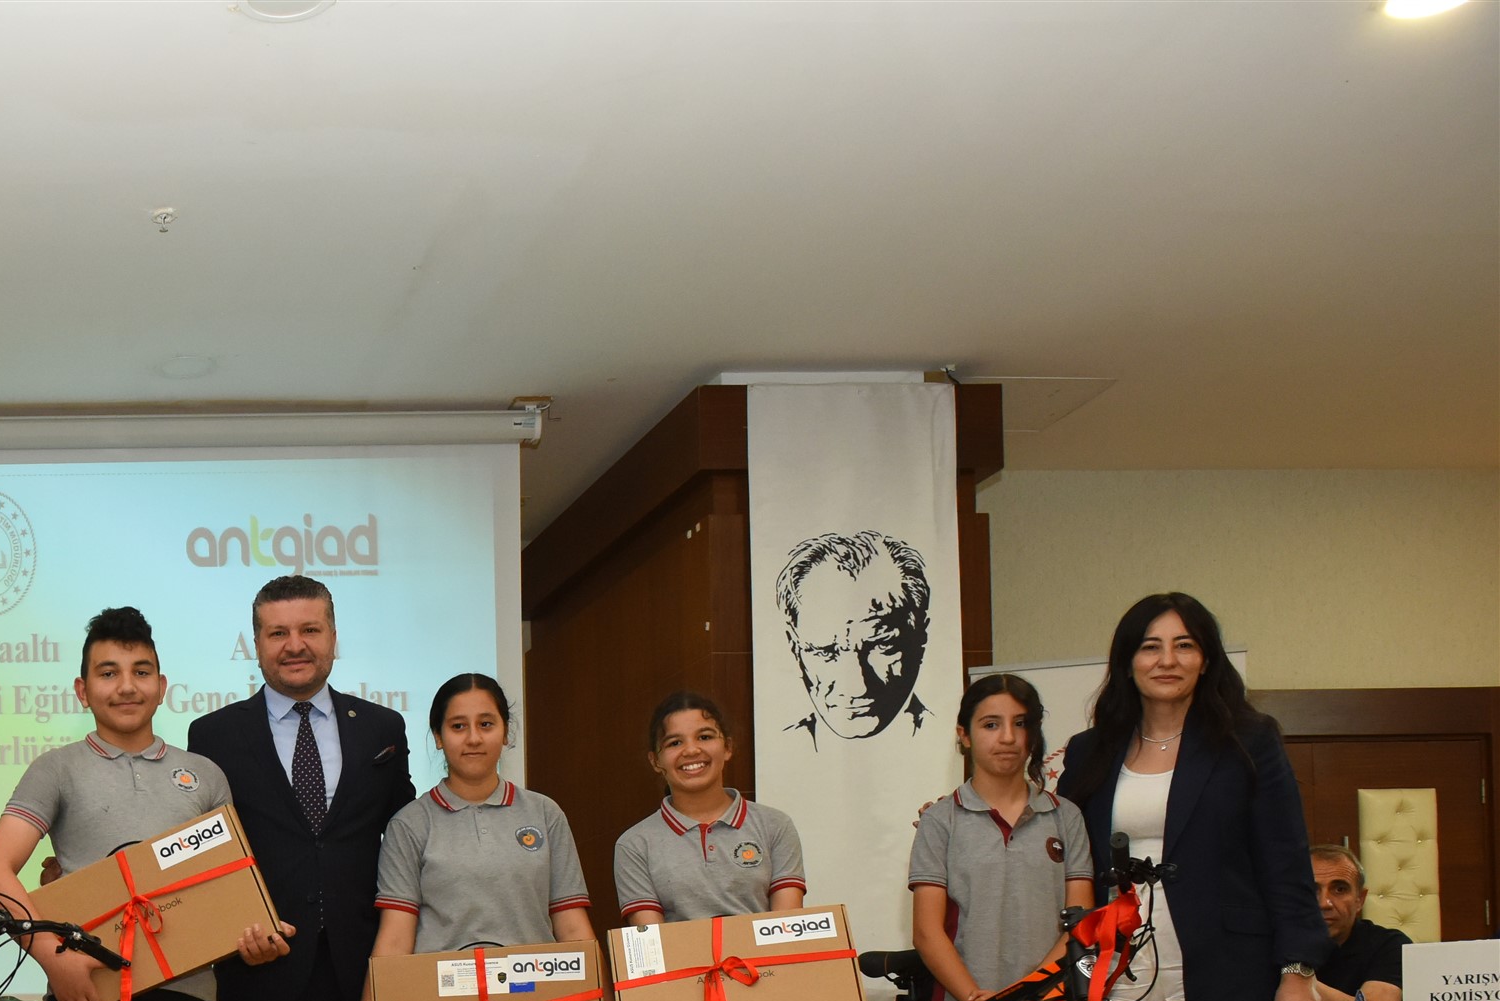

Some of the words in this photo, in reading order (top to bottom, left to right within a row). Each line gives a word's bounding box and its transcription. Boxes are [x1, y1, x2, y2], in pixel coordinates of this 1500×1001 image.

[186, 513, 378, 577] antgiad
[12, 685, 93, 724] Eğiti
[160, 820, 225, 858] antgiad
[759, 917, 831, 938] antgiad
[512, 957, 581, 977] antgiad
